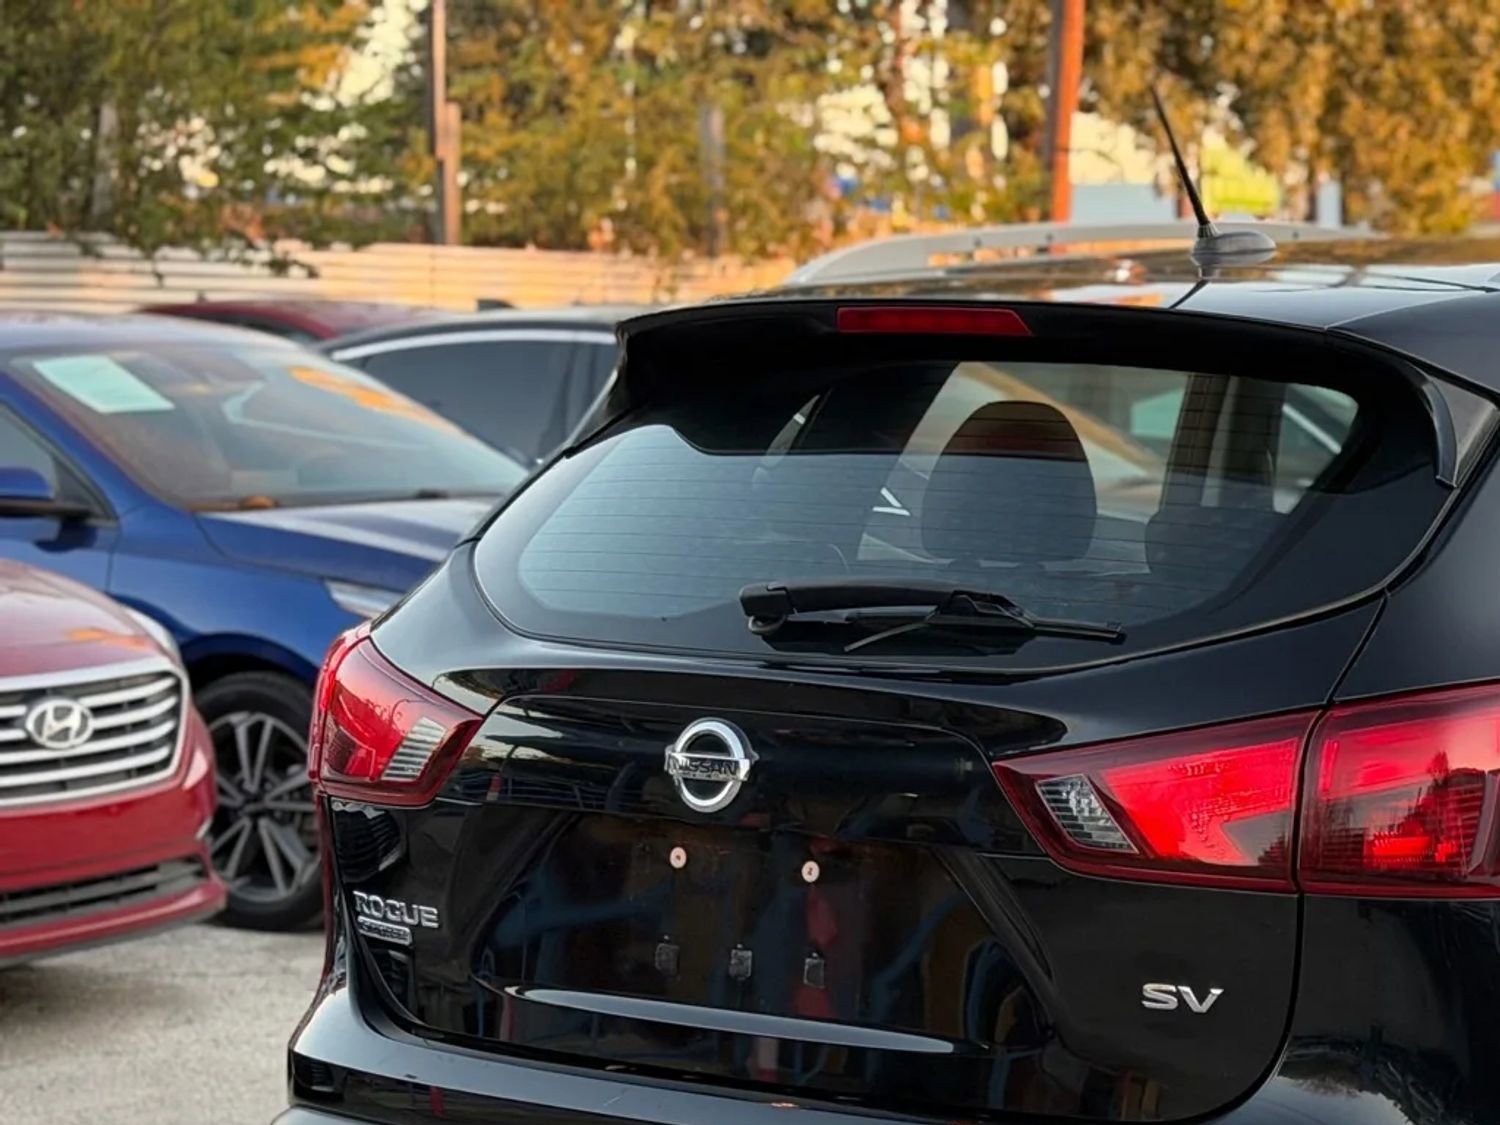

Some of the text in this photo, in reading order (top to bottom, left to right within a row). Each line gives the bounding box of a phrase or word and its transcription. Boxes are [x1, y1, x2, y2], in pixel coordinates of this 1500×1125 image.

[668, 753, 738, 777] NISSAN
[352, 890, 440, 929] ROGUE
[1141, 982, 1225, 1014] SV
